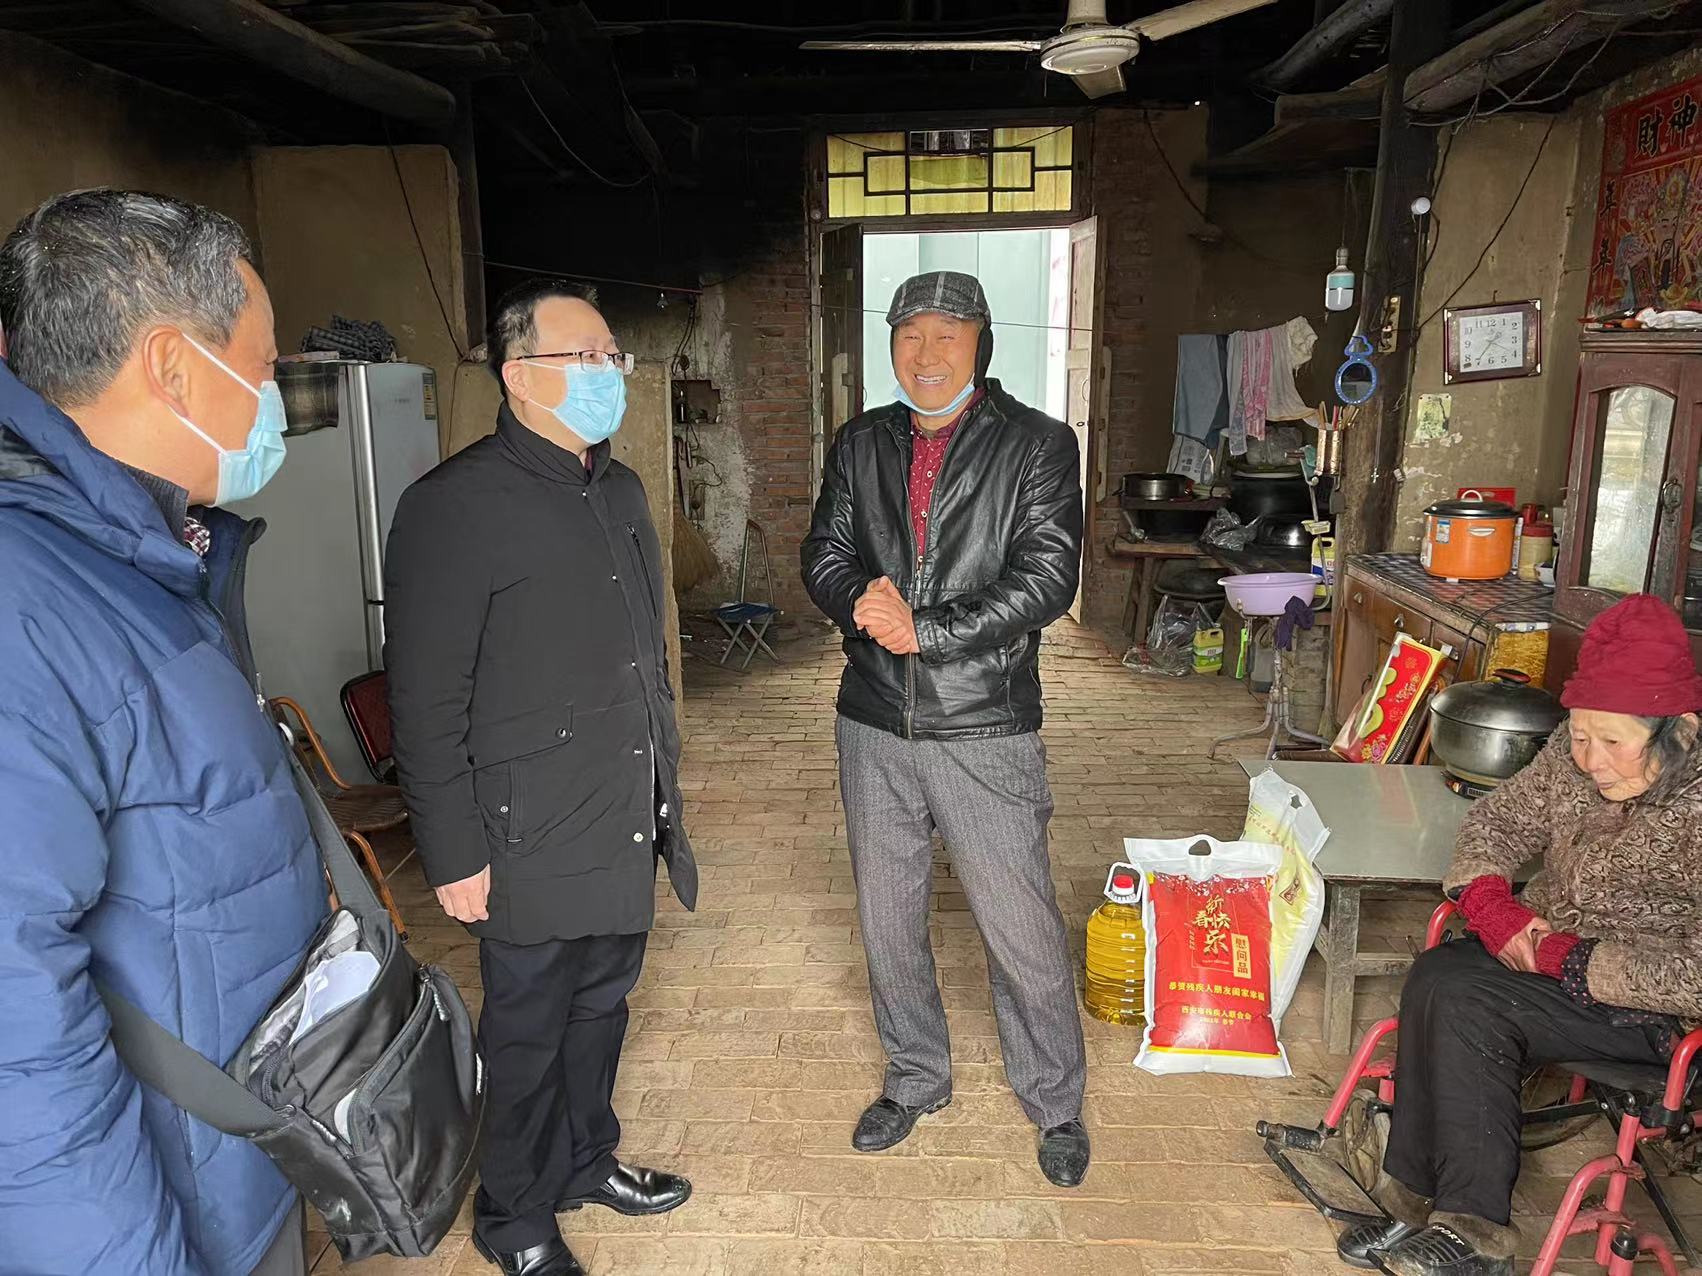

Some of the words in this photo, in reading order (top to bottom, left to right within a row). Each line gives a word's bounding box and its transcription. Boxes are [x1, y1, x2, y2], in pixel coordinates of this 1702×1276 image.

[1487, 318, 1497, 327] 12
[1511, 322, 1518, 330] 2
[1464, 340, 1471, 348] 9
[1511, 335, 1518, 344] 3
[1488, 356, 1495, 365] 6
[1501, 355, 1508, 364] 5
